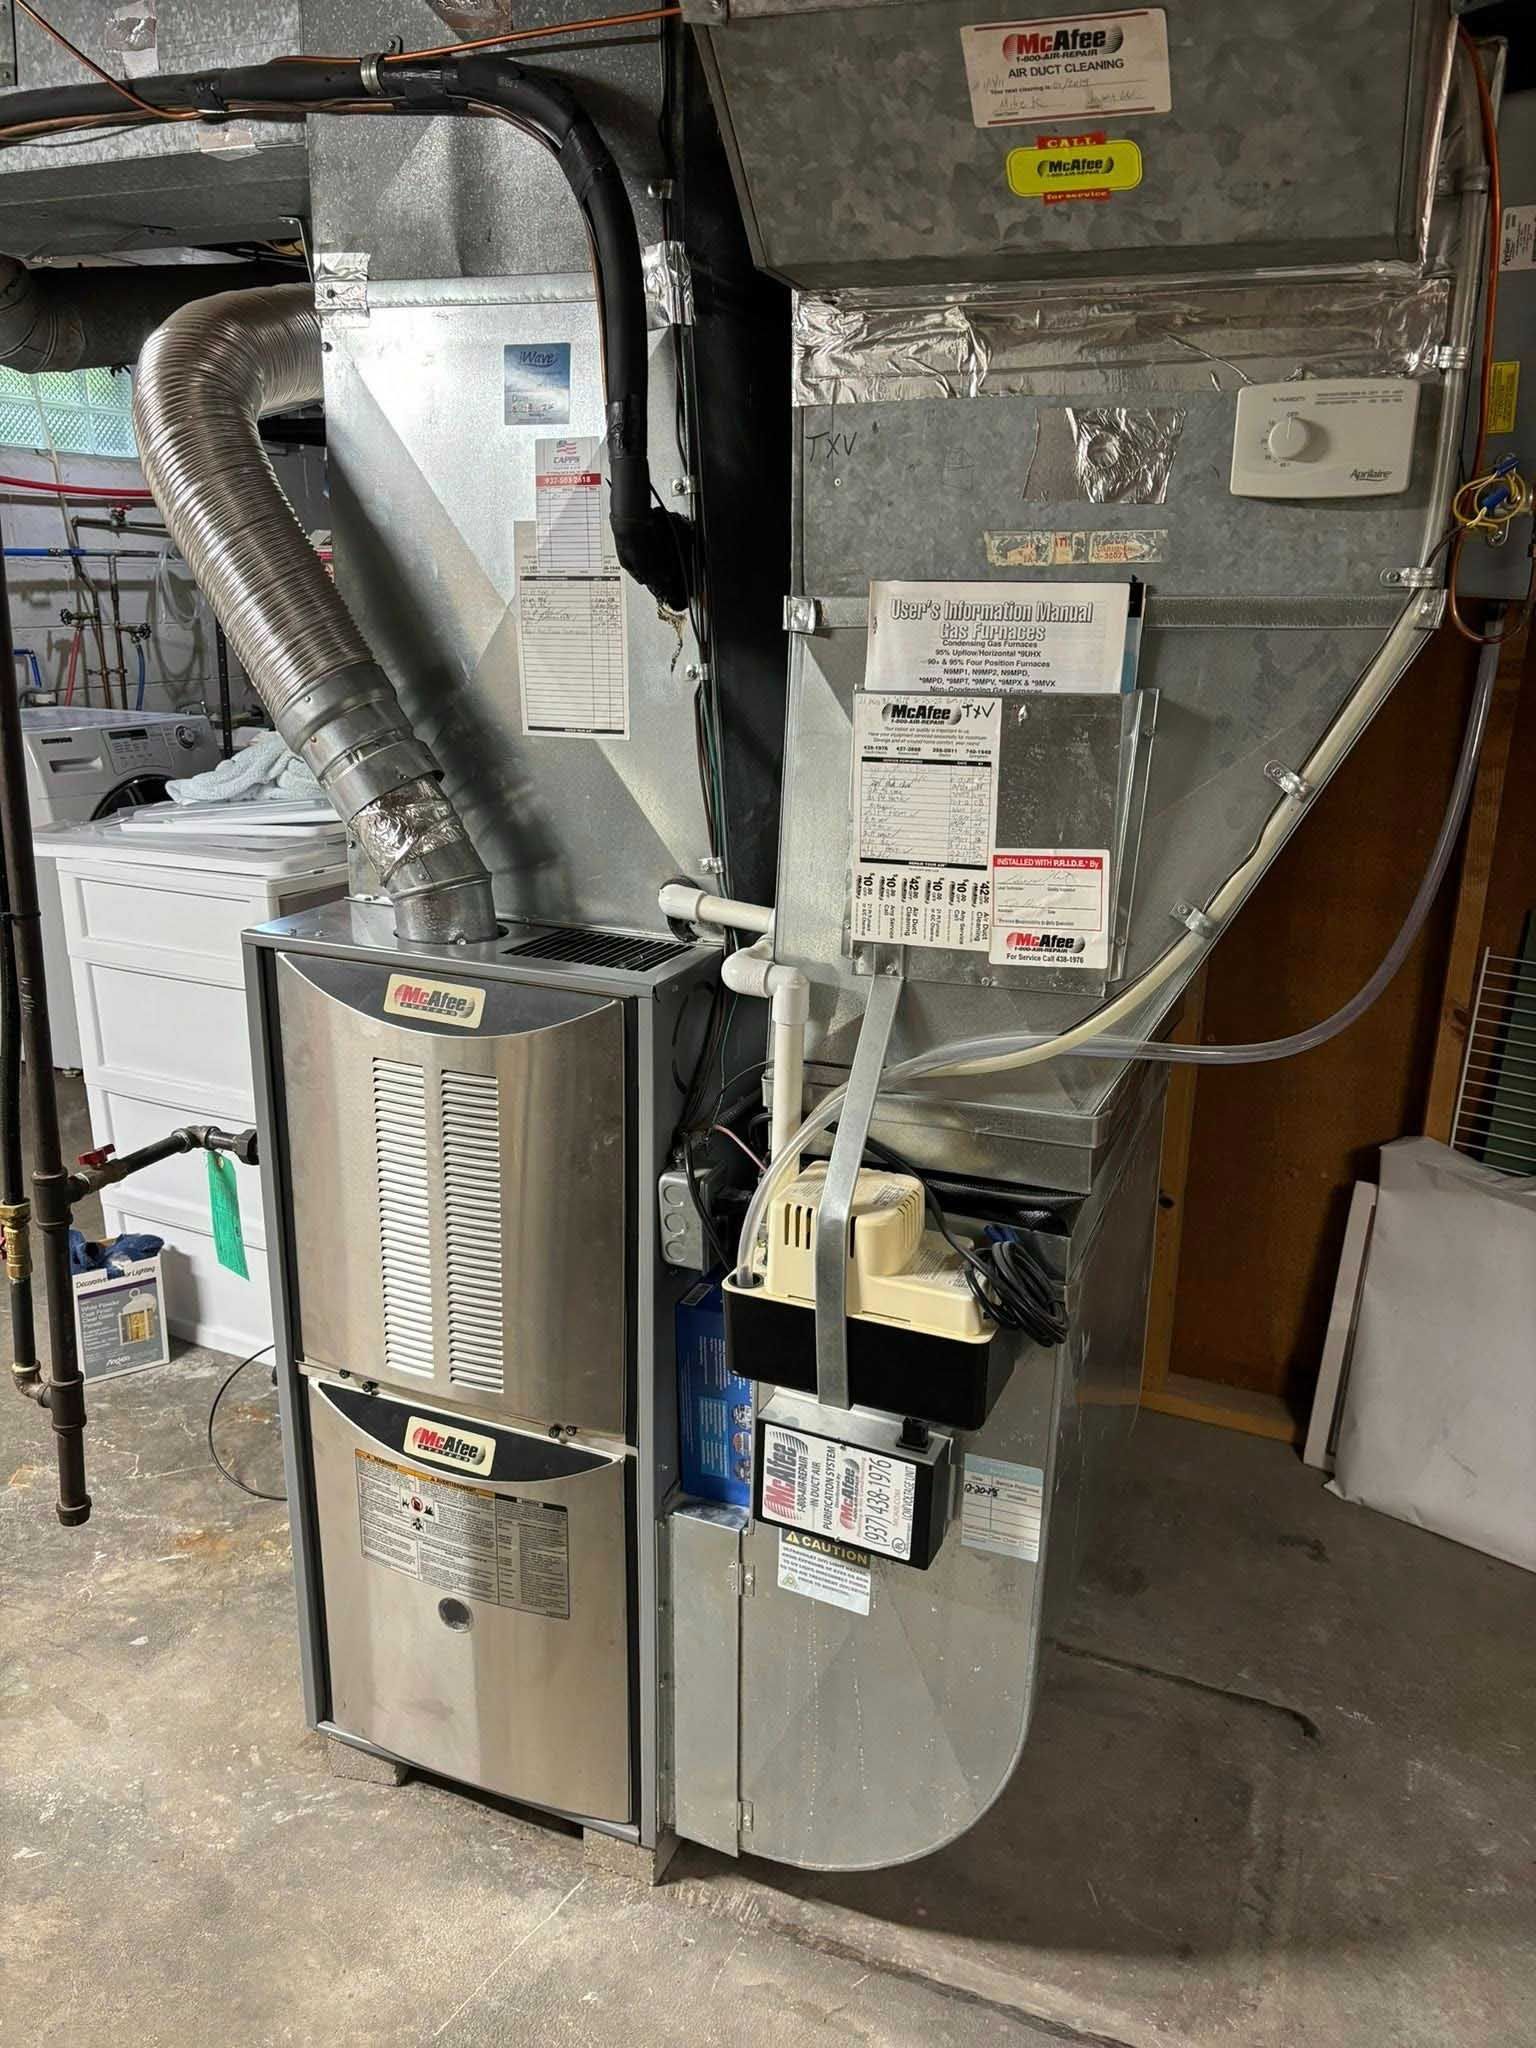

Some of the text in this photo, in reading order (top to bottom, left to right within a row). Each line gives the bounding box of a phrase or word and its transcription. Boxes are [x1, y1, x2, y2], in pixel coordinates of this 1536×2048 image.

[1016, 28, 1107, 54] McAfee
[1016, 49, 1098, 63] 1-800-AIR-REPAIR
[1008, 58, 1125, 79] AIR DUCT CLEANING
[1048, 137, 1096, 148] CALL
[1048, 159, 1103, 173] McAfee
[1065, 190, 1107, 199] service
[805, 431, 857, 462] TXV
[1350, 469, 1392, 481] Aprilaire
[890, 599, 1093, 623] User's Information Manual
[939, 623, 1046, 641] Gas Furnaces
[943, 640, 986, 648] Condensing
[891, 704, 951, 719] McAfee
[974, 912, 982, 941] Cleaning
[1016, 933, 1075, 948] McAfee
[1019, 953, 1041, 961] Service
[1042, 954, 1055, 962] Call
[401, 985, 467, 1011] McAfee
[132, 1266, 155, 1277] Lighting
[419, 1428, 478, 1458] McAfee
[765, 1442, 797, 1510] McAfee
[797, 1455, 809, 1513] 1-800-AIR-REPAIR
[810, 1462, 821, 1507] IN DUCT AIR
[823, 1445, 836, 1530] PURIFICATION SYSTEM
[840, 1468, 855, 1522] McAfee
[864, 1458, 892, 1546] (937) 438-1976
[802, 1536, 867, 1565] CAUTION
